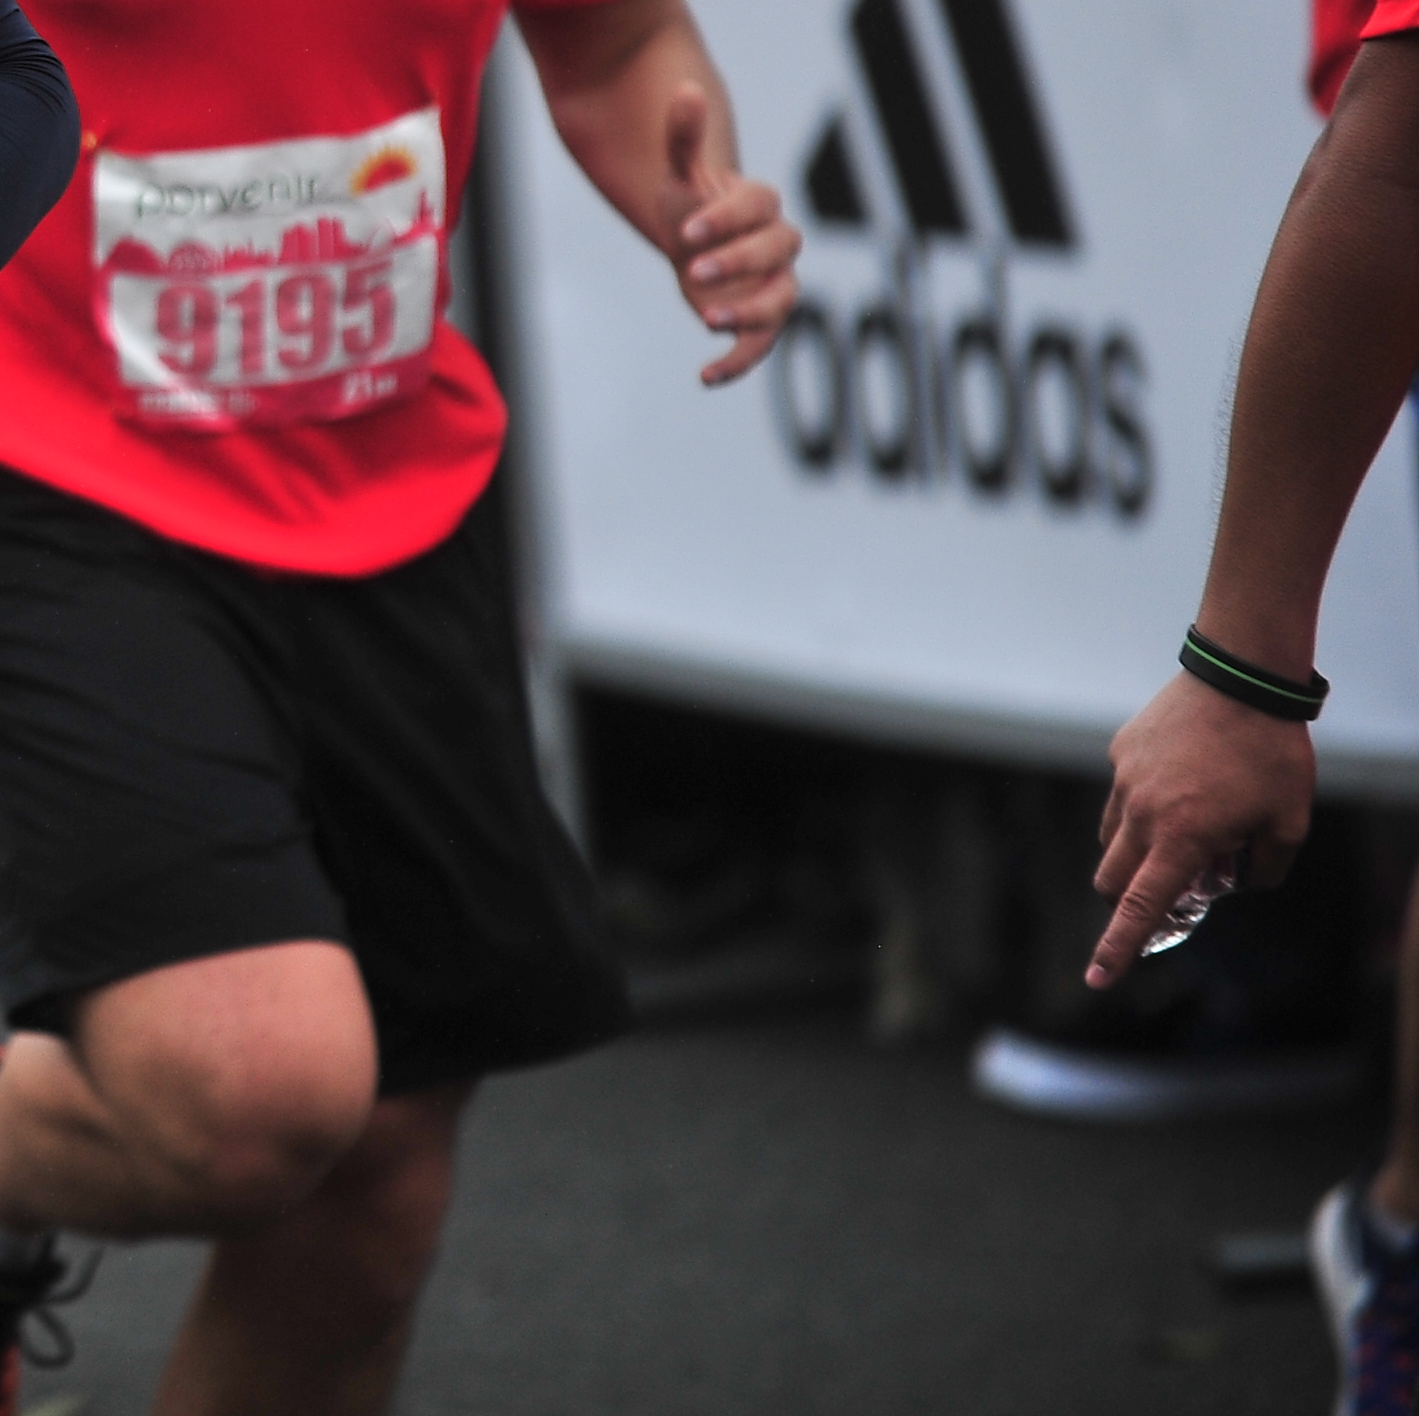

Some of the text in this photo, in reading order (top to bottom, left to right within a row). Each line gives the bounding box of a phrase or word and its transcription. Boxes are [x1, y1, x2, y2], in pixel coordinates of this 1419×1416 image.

[137, 174, 320, 218] porvenir
[156, 260, 396, 377] 9195
[769, 240, 1155, 520] adidas
